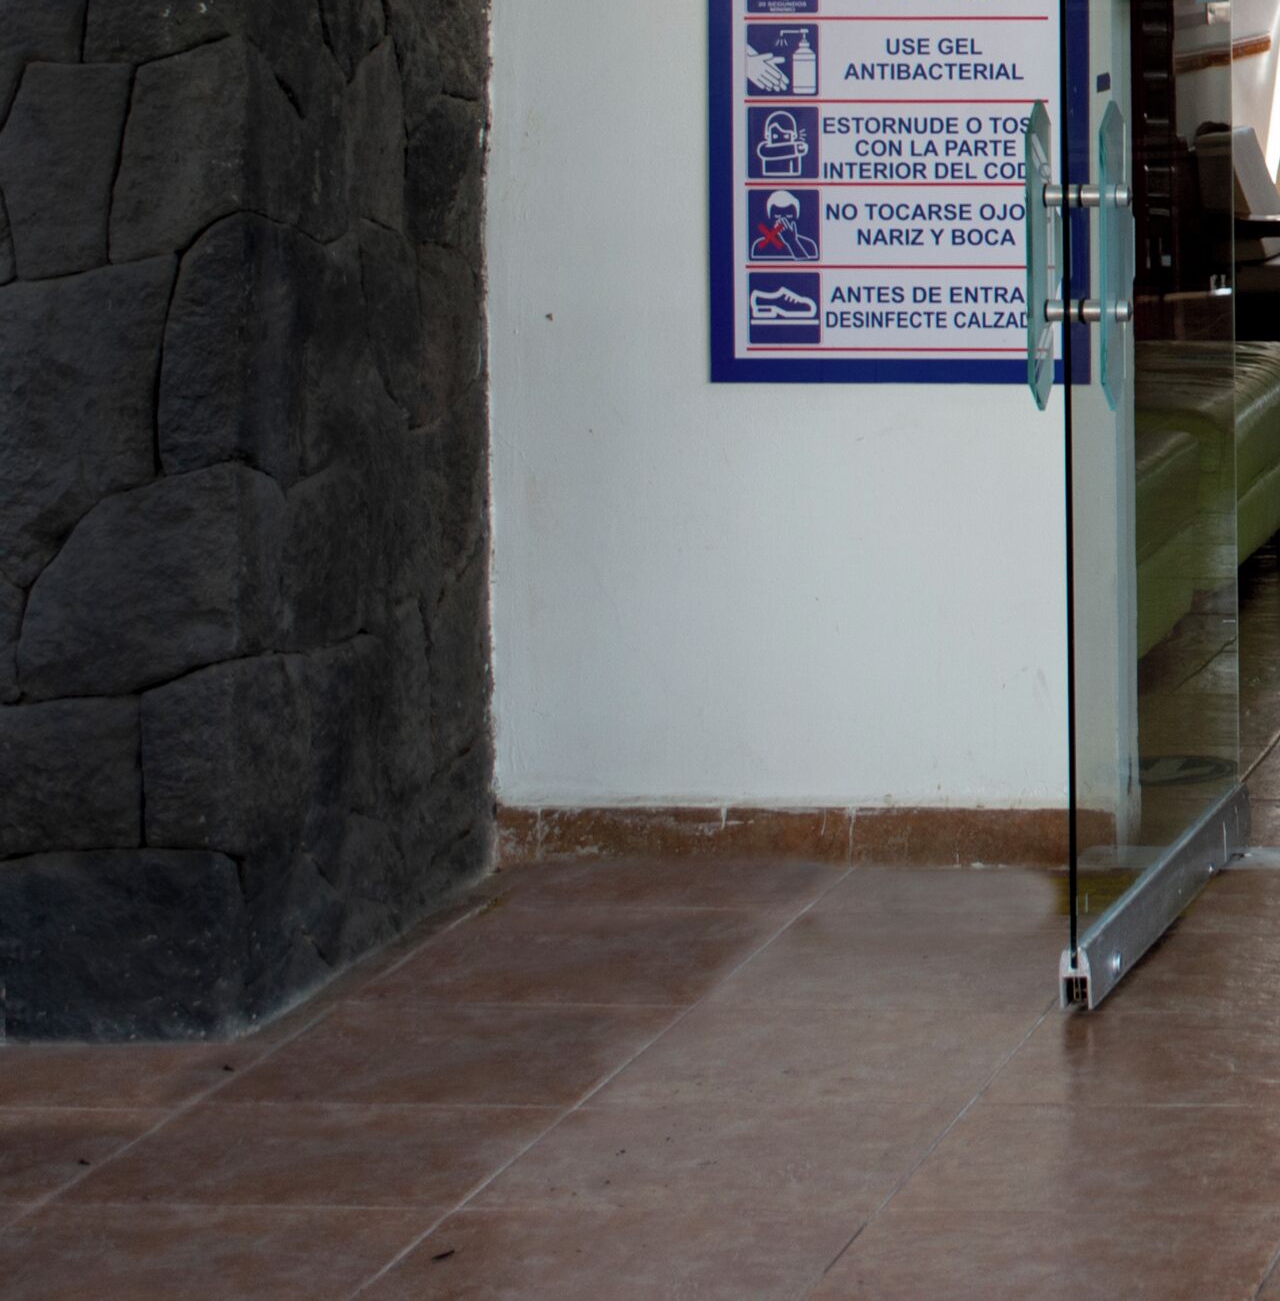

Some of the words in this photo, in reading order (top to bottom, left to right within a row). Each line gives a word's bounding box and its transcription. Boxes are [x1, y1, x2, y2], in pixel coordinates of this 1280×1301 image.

[887, 38, 930, 55] USE
[938, 38, 982, 55] GEL
[845, 63, 1024, 80] ANTIBACTERIAL
[823, 117, 958, 134] ESTORNUDE
[967, 117, 982, 134] O
[989, 117, 1033, 134] TOS
[856, 140, 902, 157] CON
[911, 140, 938, 156] LA
[946, 140, 1016, 156] PARTE
[824, 162, 927, 179] INTERIOR
[935, 162, 977, 179] DEL
[826, 204, 857, 220] NO
[865, 204, 972, 221] TOCARSE
[980, 204, 1025, 221] OJO
[858, 229, 924, 245] NARIZ
[931, 229, 944, 245] Y
[952, 229, 1015, 245] BOCA
[831, 287, 904, 303] ANTES
[913, 287, 941, 303] DE
[950, 287, 1025, 303] ENTRA
[826, 311, 947, 328] DESINFECTE
[954, 312, 1027, 328] CALZAD
